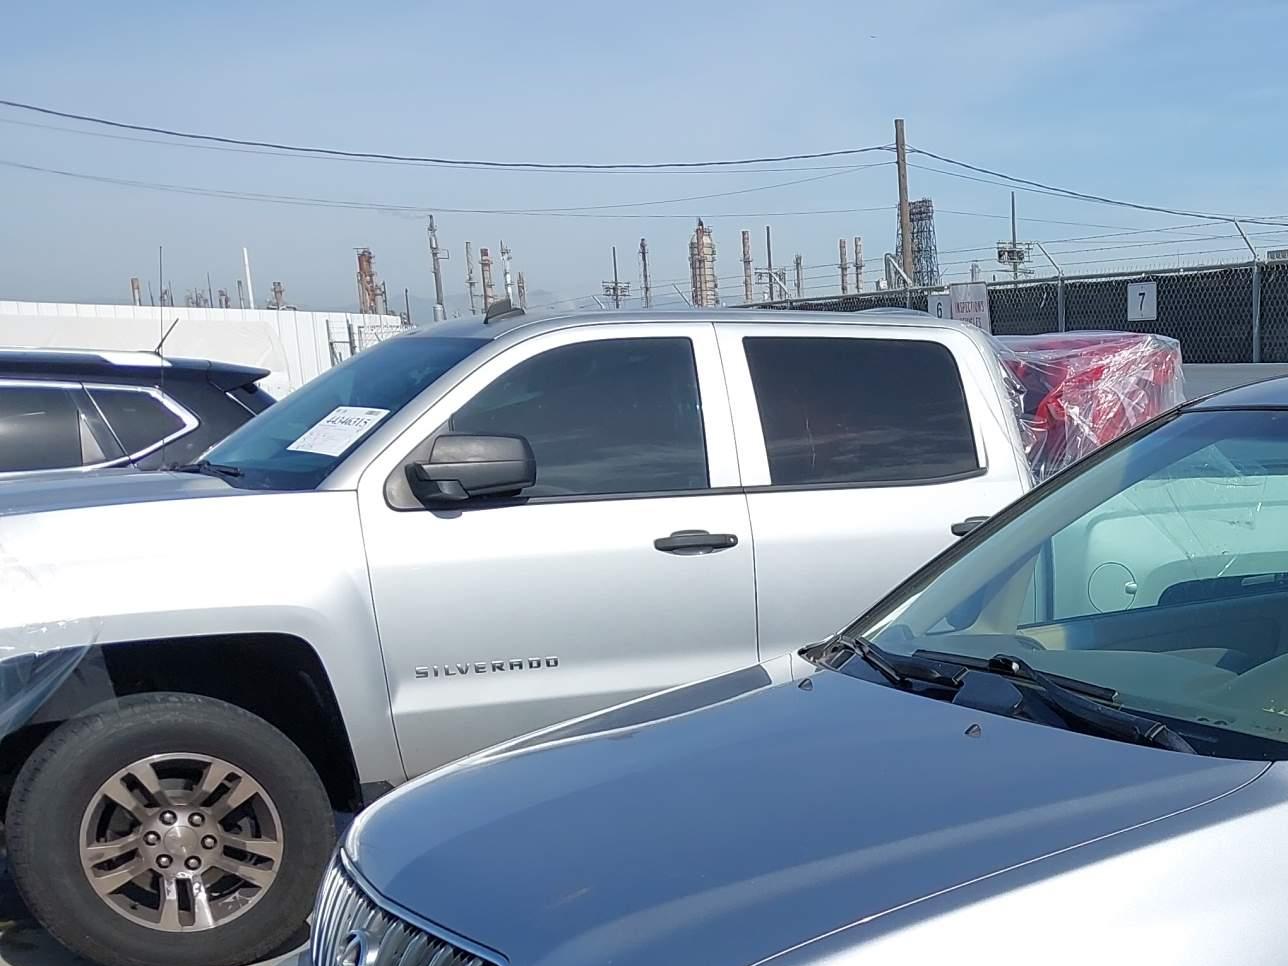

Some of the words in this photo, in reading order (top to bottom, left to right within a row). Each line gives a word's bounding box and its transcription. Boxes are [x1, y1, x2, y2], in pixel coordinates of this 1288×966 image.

[936, 301, 943, 318] 6
[1137, 292, 1146, 311] 7
[415, 656, 559, 679] SILVERADO
